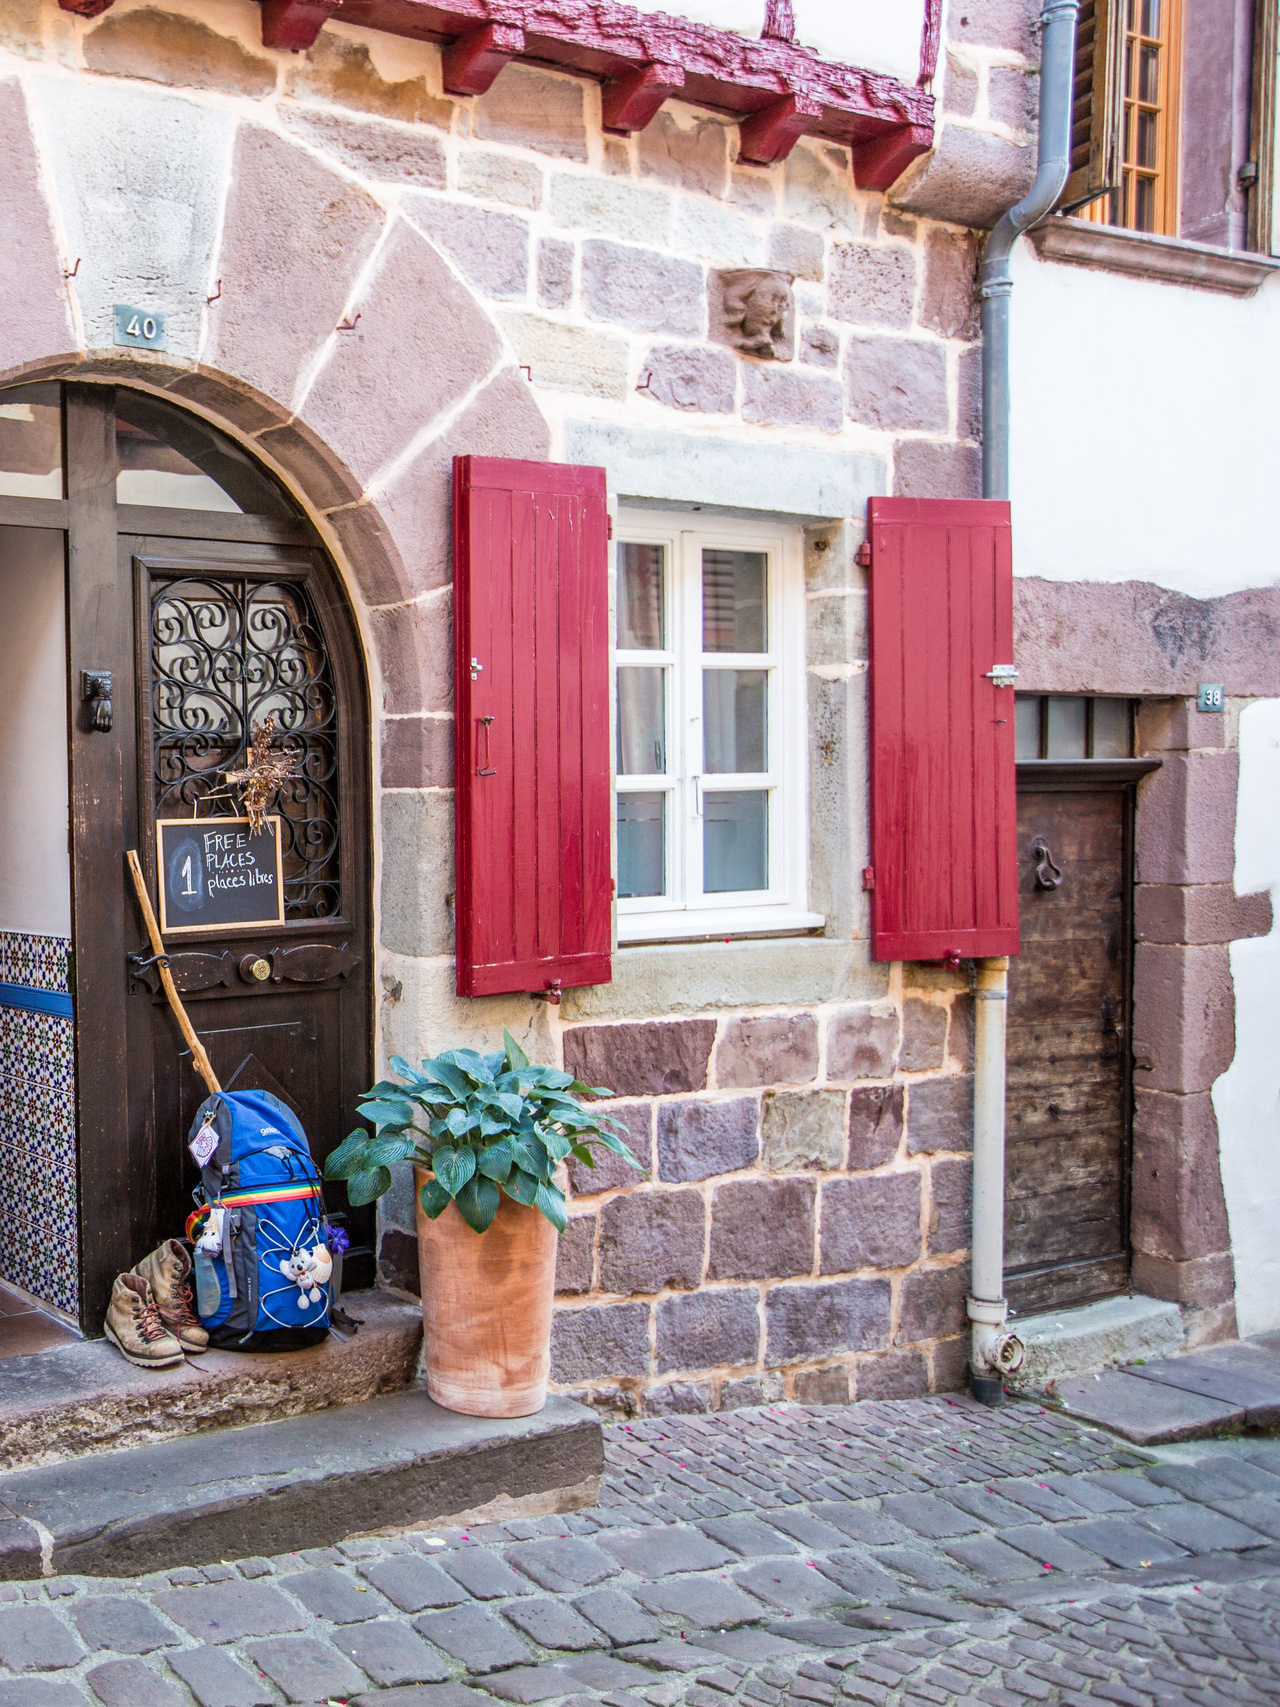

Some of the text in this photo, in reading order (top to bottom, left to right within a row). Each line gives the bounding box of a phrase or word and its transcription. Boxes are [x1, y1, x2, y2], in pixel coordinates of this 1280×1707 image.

[126, 315, 157, 339] 40
[1205, 689, 1220, 705] 38
[203, 831, 247, 853] FREE
[206, 851, 255, 871] PLACES
[181, 855, 197, 895] 1
[207, 868, 274, 898] places libres
